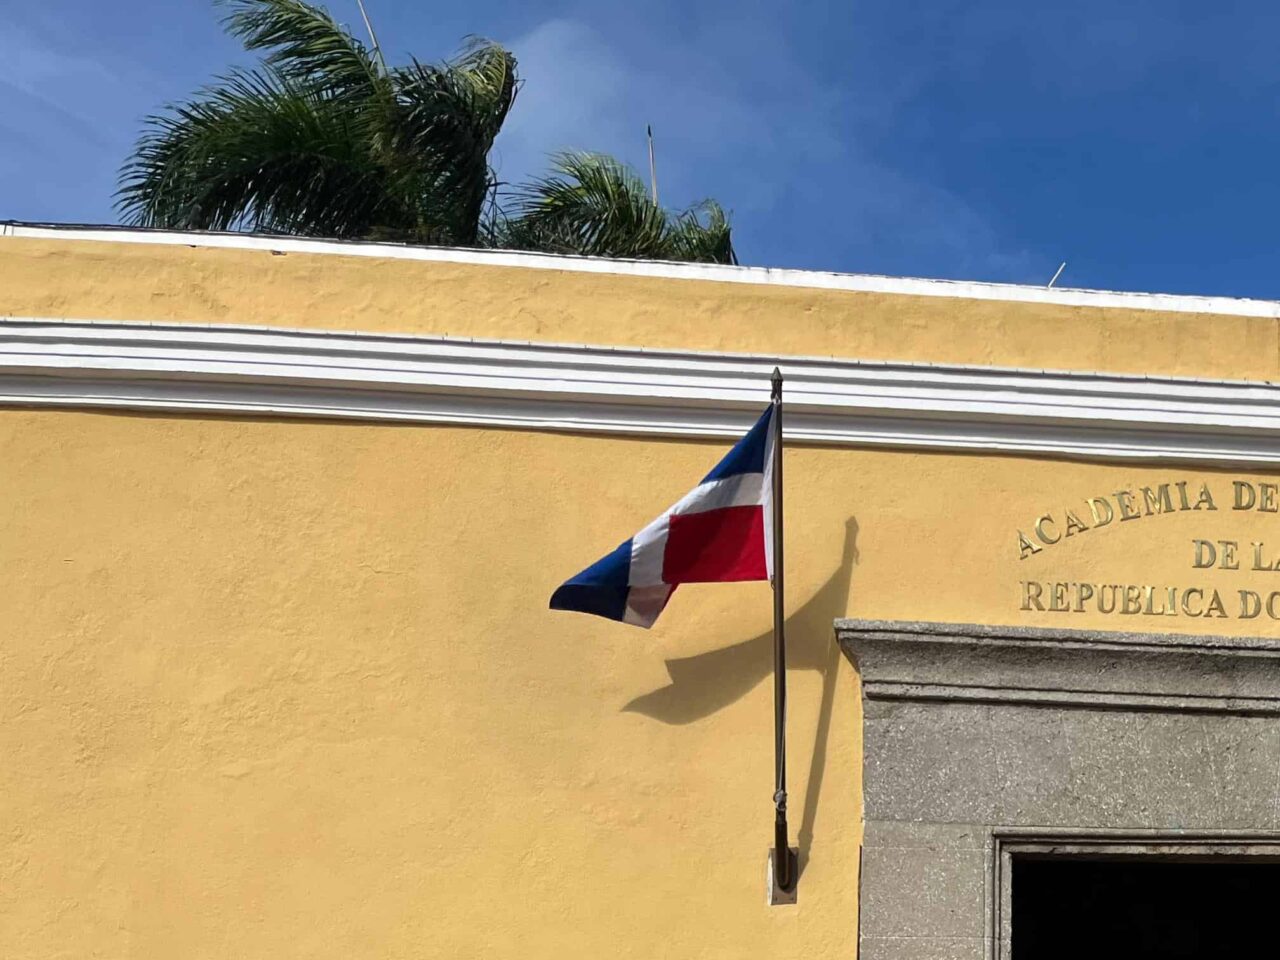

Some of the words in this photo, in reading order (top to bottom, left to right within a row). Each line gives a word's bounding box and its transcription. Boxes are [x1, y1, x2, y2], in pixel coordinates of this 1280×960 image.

[1016, 481, 1218, 560] ACADEMIA
[1232, 480, 1279, 513] DE
[1192, 539, 1240, 570] DE
[1019, 580, 1228, 618] REPUBLICA
